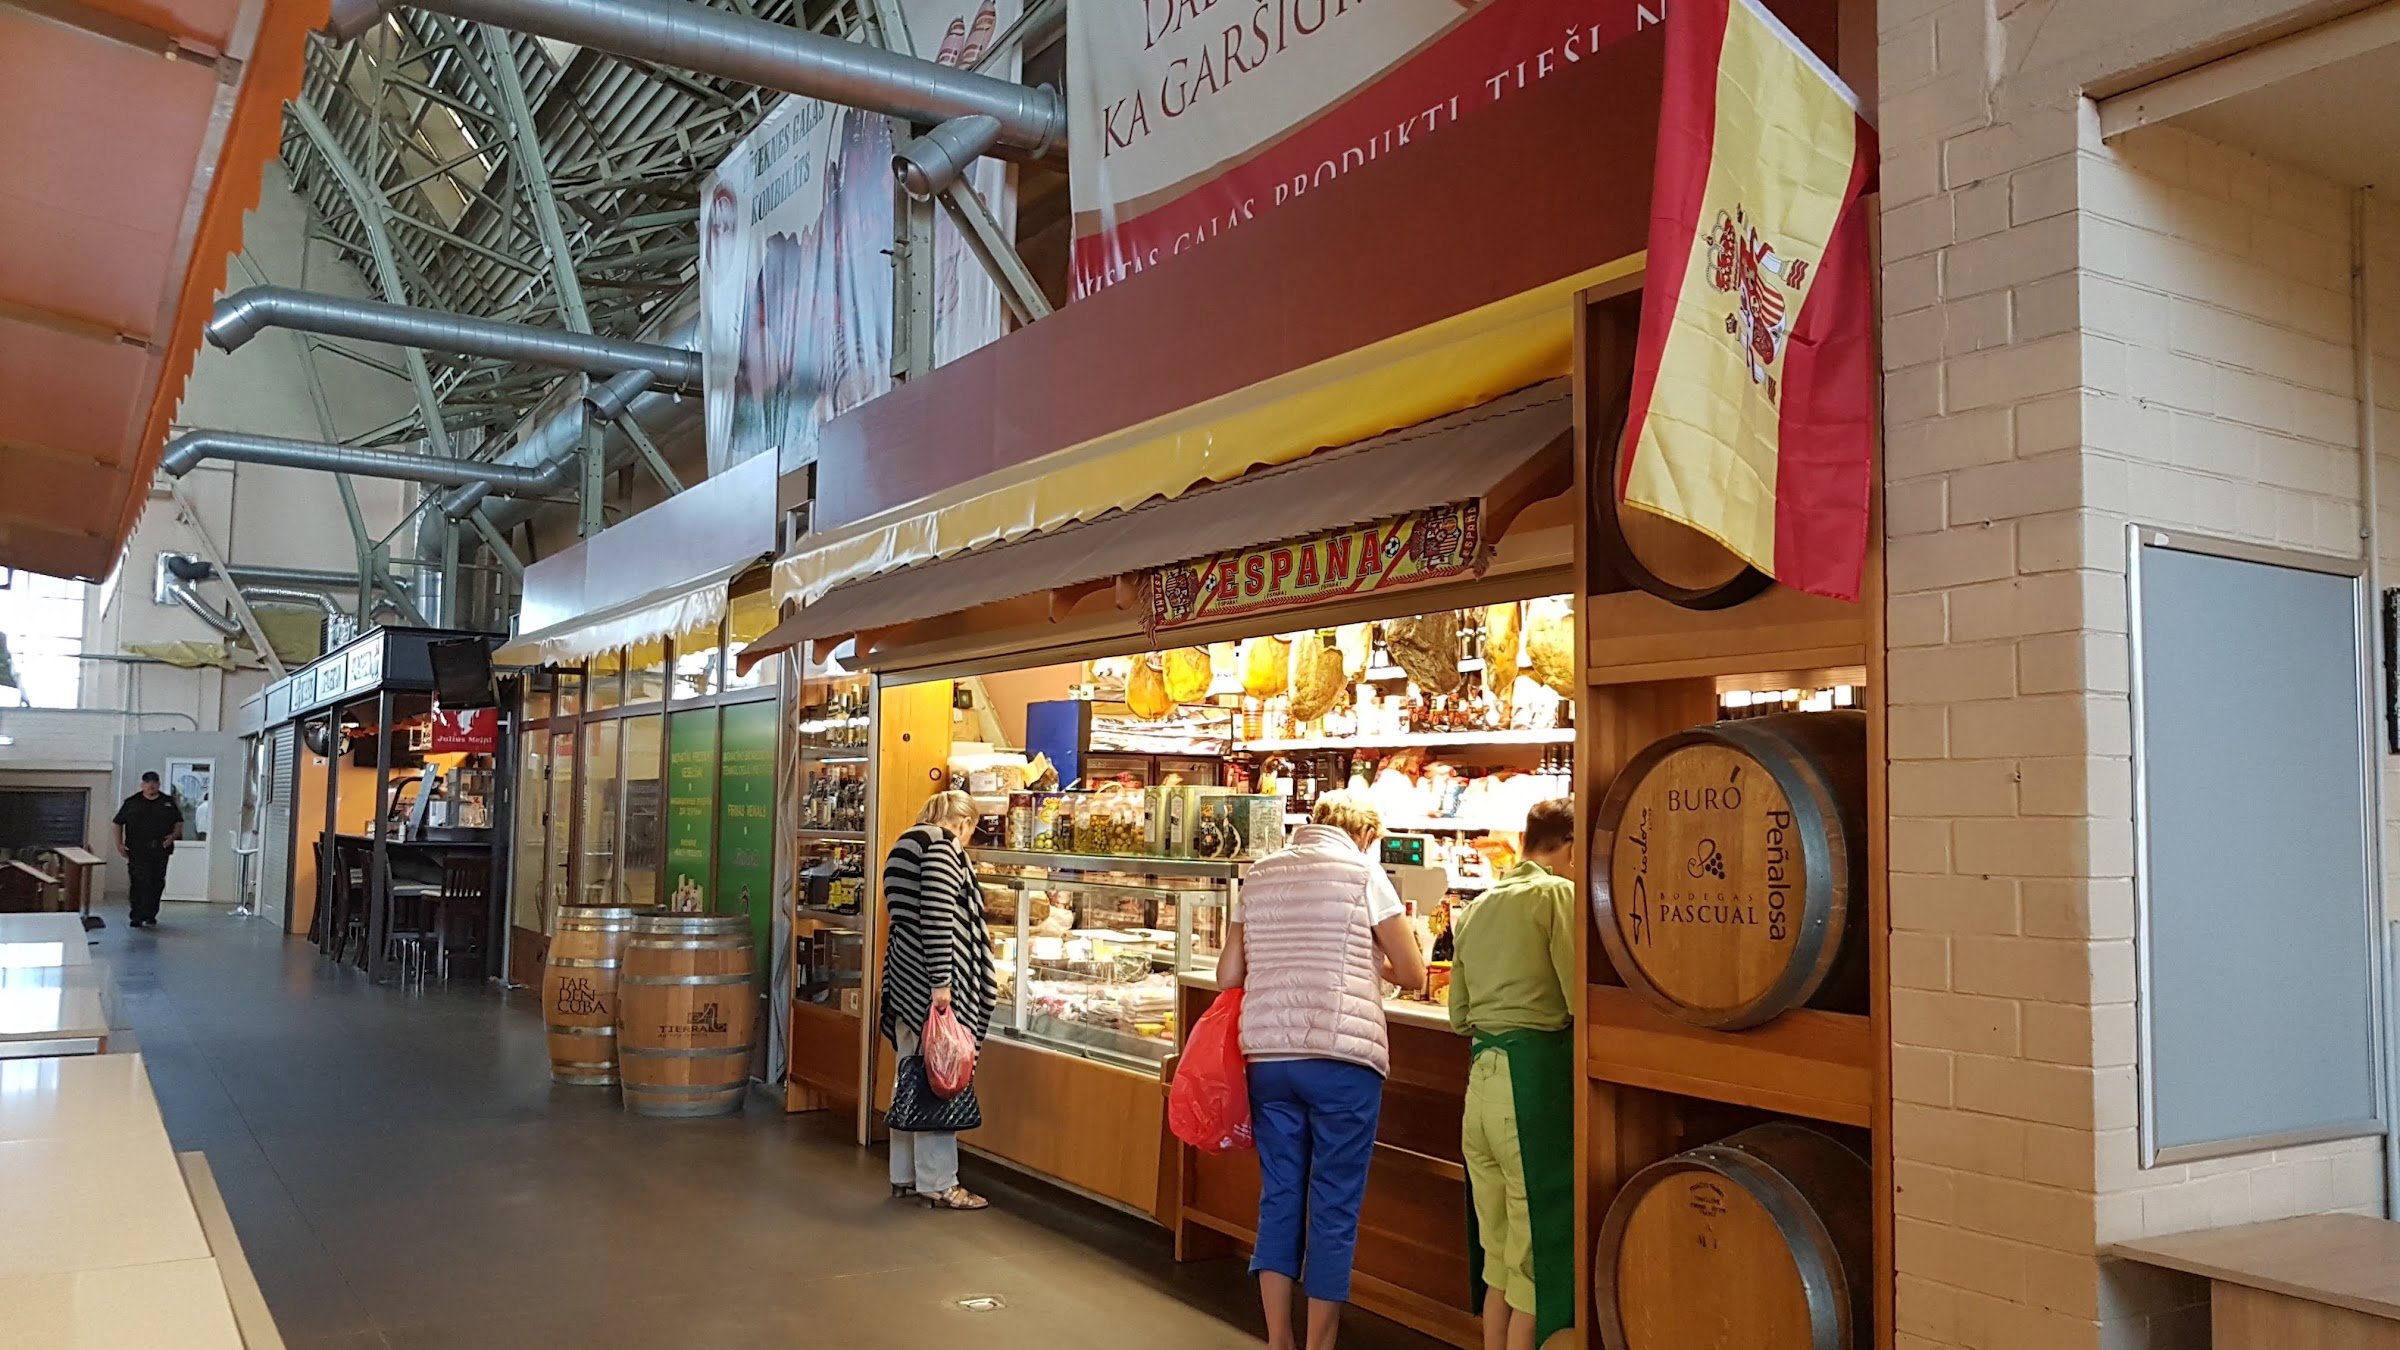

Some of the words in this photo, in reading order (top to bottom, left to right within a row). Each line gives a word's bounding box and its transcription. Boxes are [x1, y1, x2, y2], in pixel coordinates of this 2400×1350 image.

[1103, 88, 1151, 158] KA
[437, 735, 466, 744] Julius
[1668, 765, 1742, 812] BURÓ
[1766, 810, 1792, 941] Peñalosa
[1660, 892, 1754, 901] BODEGAS
[1660, 904, 1759, 925] PASCUAL
[559, 976, 590, 991] TAR
[558, 989, 596, 1002] DEN
[557, 1000, 608, 1015] CUBA
